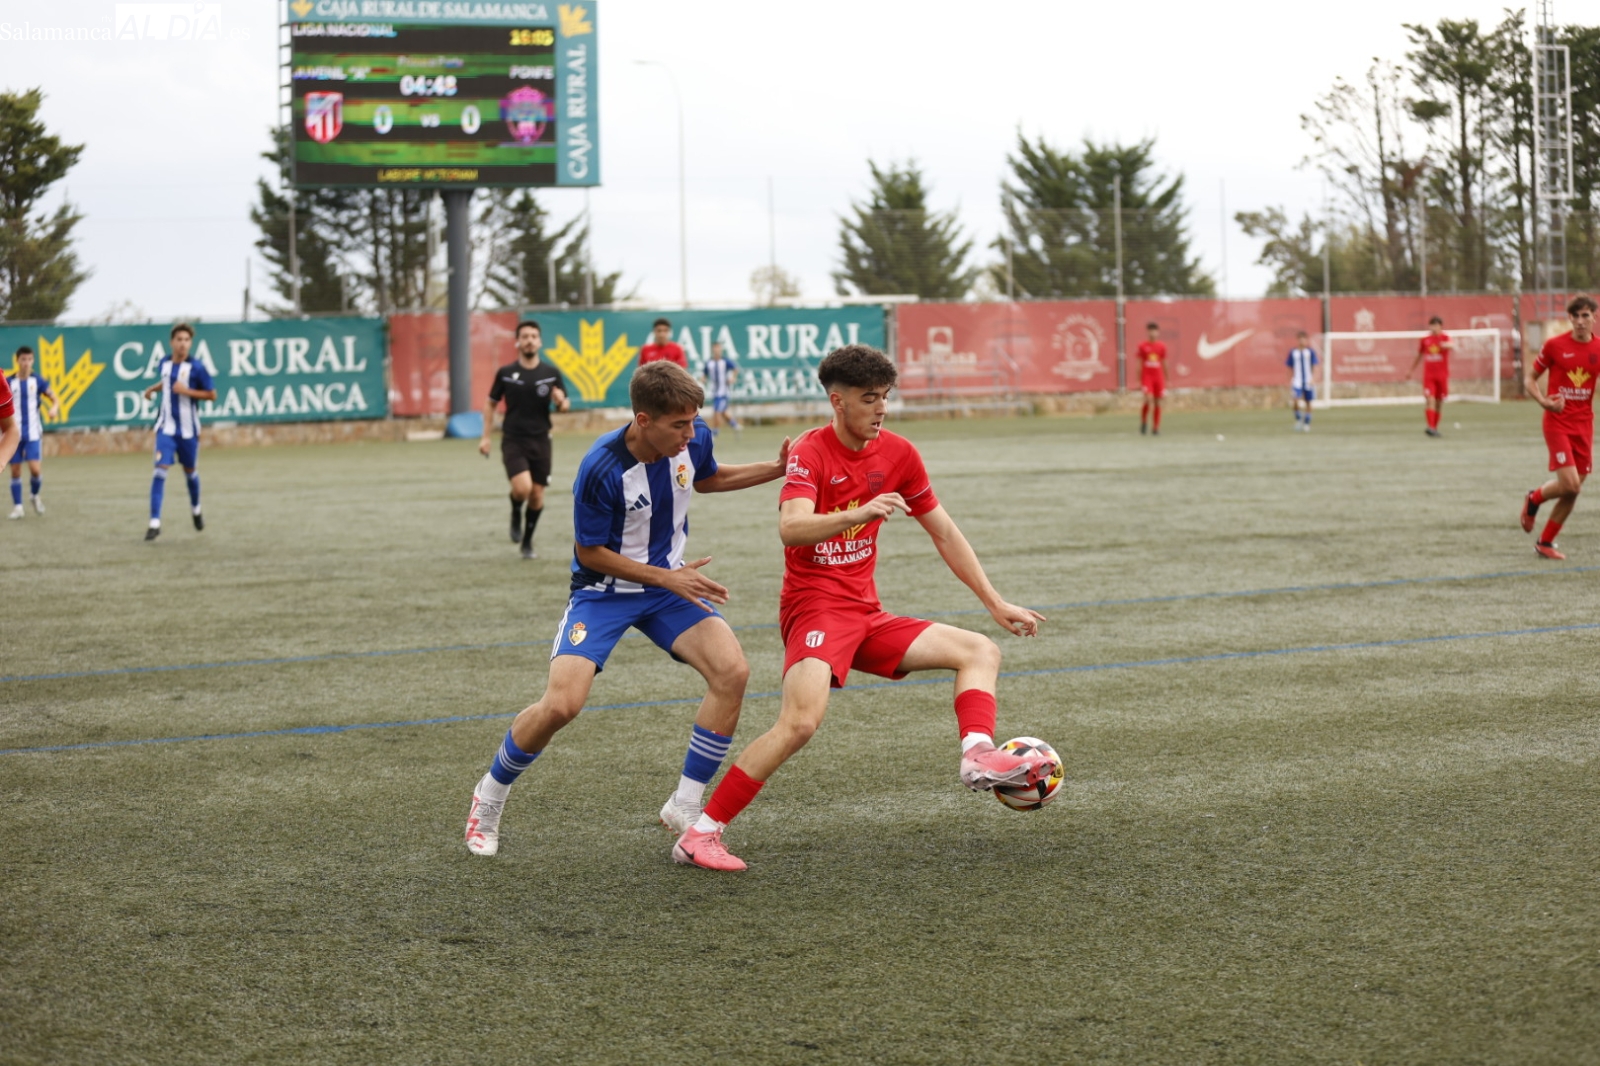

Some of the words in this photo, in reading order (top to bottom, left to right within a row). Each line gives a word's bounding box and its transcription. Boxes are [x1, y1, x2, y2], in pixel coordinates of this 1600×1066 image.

[315, 0, 359, 20] CAJA
[361, 1, 421, 19] RURAL
[422, 3, 442, 19] DE
[443, 3, 549, 21] SALAMANCA
[292, 24, 325, 37] LIGA
[327, 24, 397, 38] NACIONAL
[567, 43, 588, 118] RURAL
[461, 105, 481, 135] 0
[567, 122, 592, 180] CAJA
[113, 339, 219, 380] CAA
[228, 335, 367, 376] RURAL
[645, 324, 740, 361] AJA
[813, 556, 827, 565] DE
[827, 547, 873, 565] SALAMANCA
[815, 541, 843, 556] CAJA
